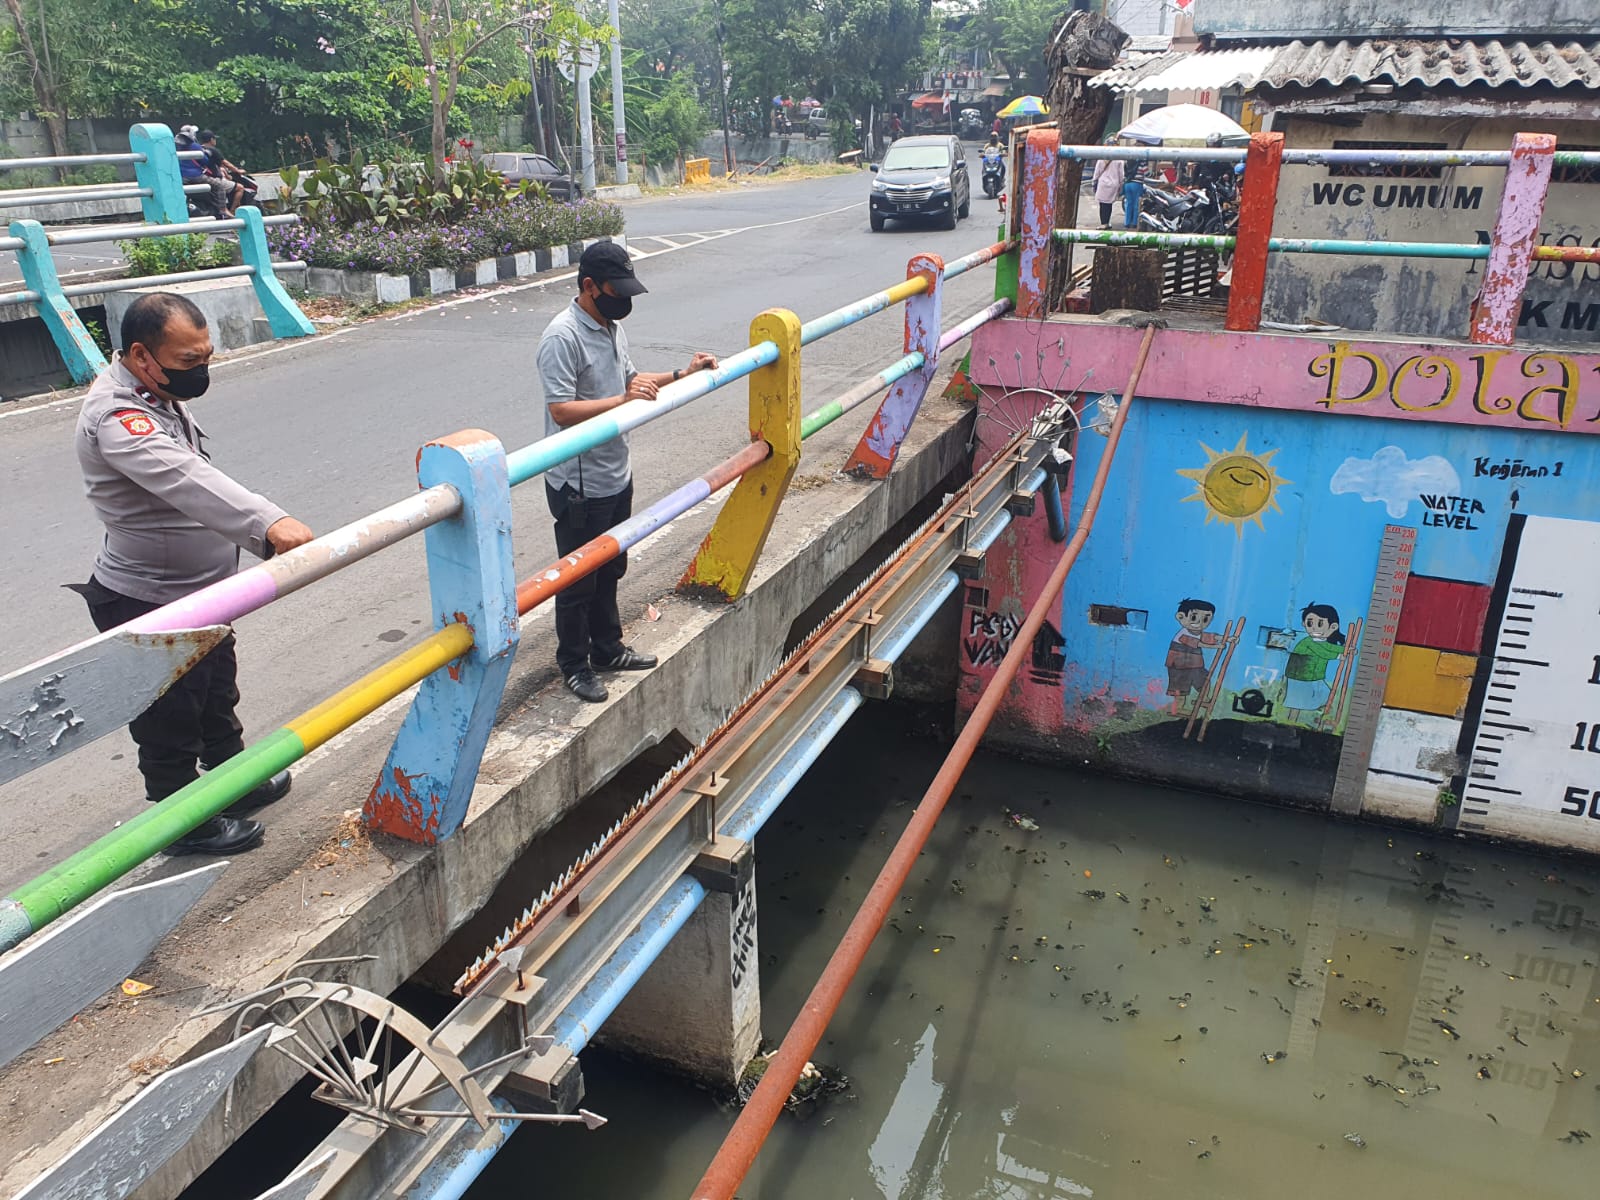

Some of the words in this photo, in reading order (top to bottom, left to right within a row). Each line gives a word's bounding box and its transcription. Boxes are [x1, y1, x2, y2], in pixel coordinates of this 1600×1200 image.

[1312, 182, 1366, 206] WC
[1372, 183, 1483, 210] UMUM
[1420, 494, 1485, 514] WATER
[1422, 511, 1479, 530] LEVEL
[1401, 529, 1415, 538] 230
[1398, 543, 1412, 552] 220
[1396, 557, 1410, 566] 210
[1393, 570, 1406, 580] 200
[1392, 584, 1404, 593] 190
[1386, 611, 1399, 620] 170
